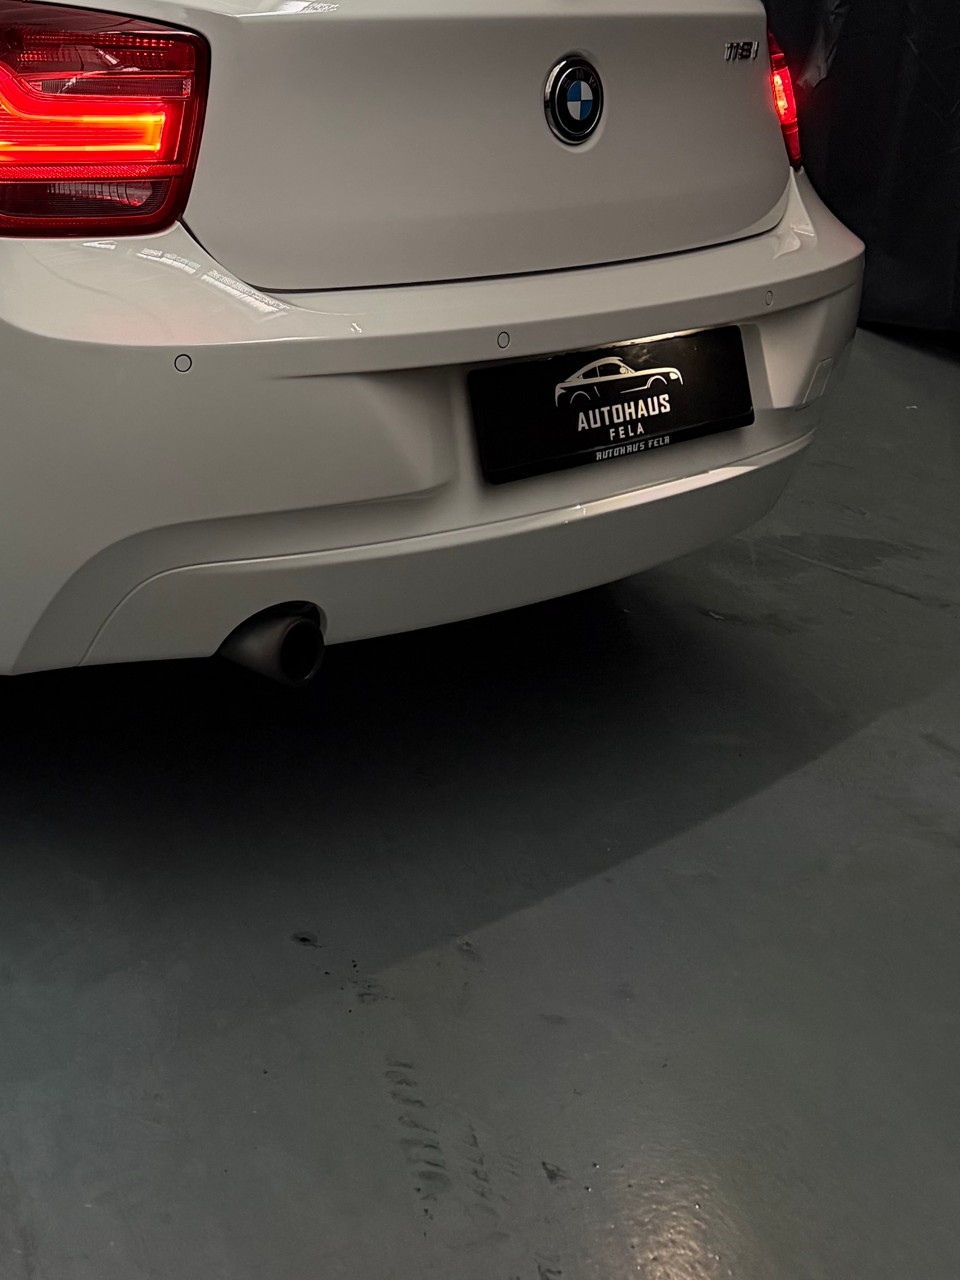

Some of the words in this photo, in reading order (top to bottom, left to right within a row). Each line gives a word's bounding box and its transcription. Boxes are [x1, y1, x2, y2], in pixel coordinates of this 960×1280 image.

[577, 394, 671, 432] AUTOHAUS
[609, 422, 645, 441] FELA
[595, 441, 646, 461] AUTOHAUS
[648, 435, 671, 450] FELA
